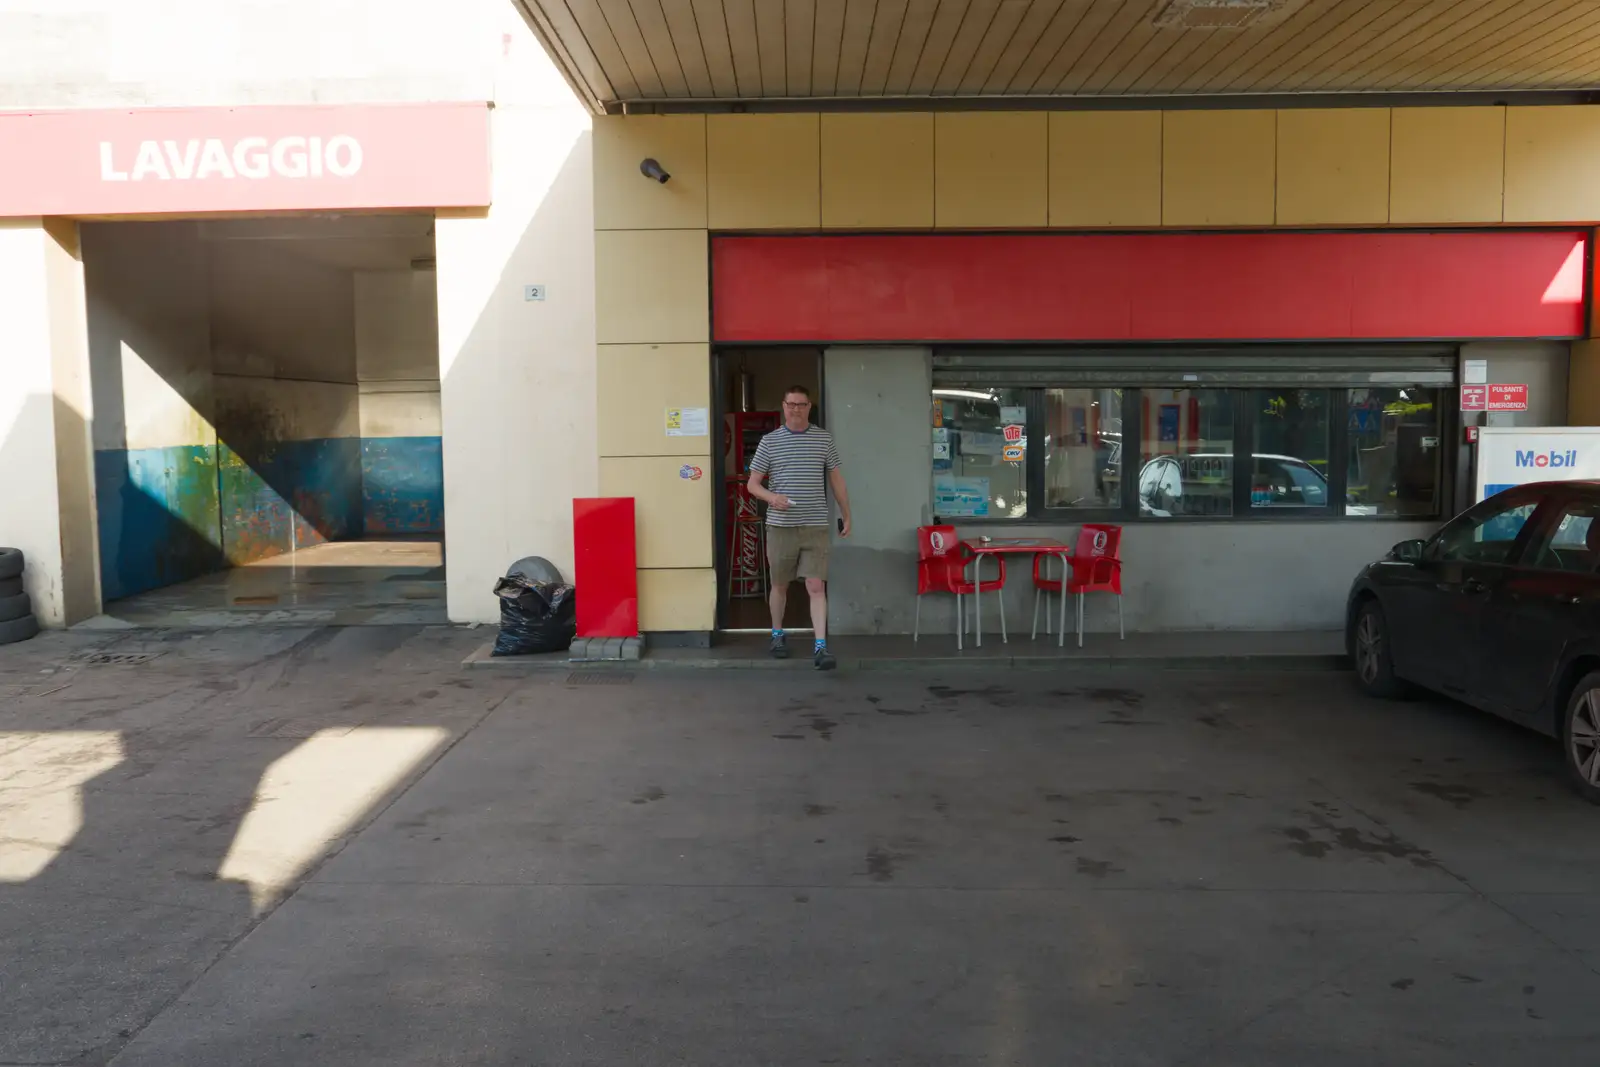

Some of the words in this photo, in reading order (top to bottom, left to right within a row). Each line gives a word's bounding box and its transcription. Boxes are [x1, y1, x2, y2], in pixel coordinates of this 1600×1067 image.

[99, 134, 363, 181] LAVAGGIO
[531, 287, 539, 297] 2
[1005, 427, 1021, 440] UTA
[1515, 450, 1577, 467] Mobil
